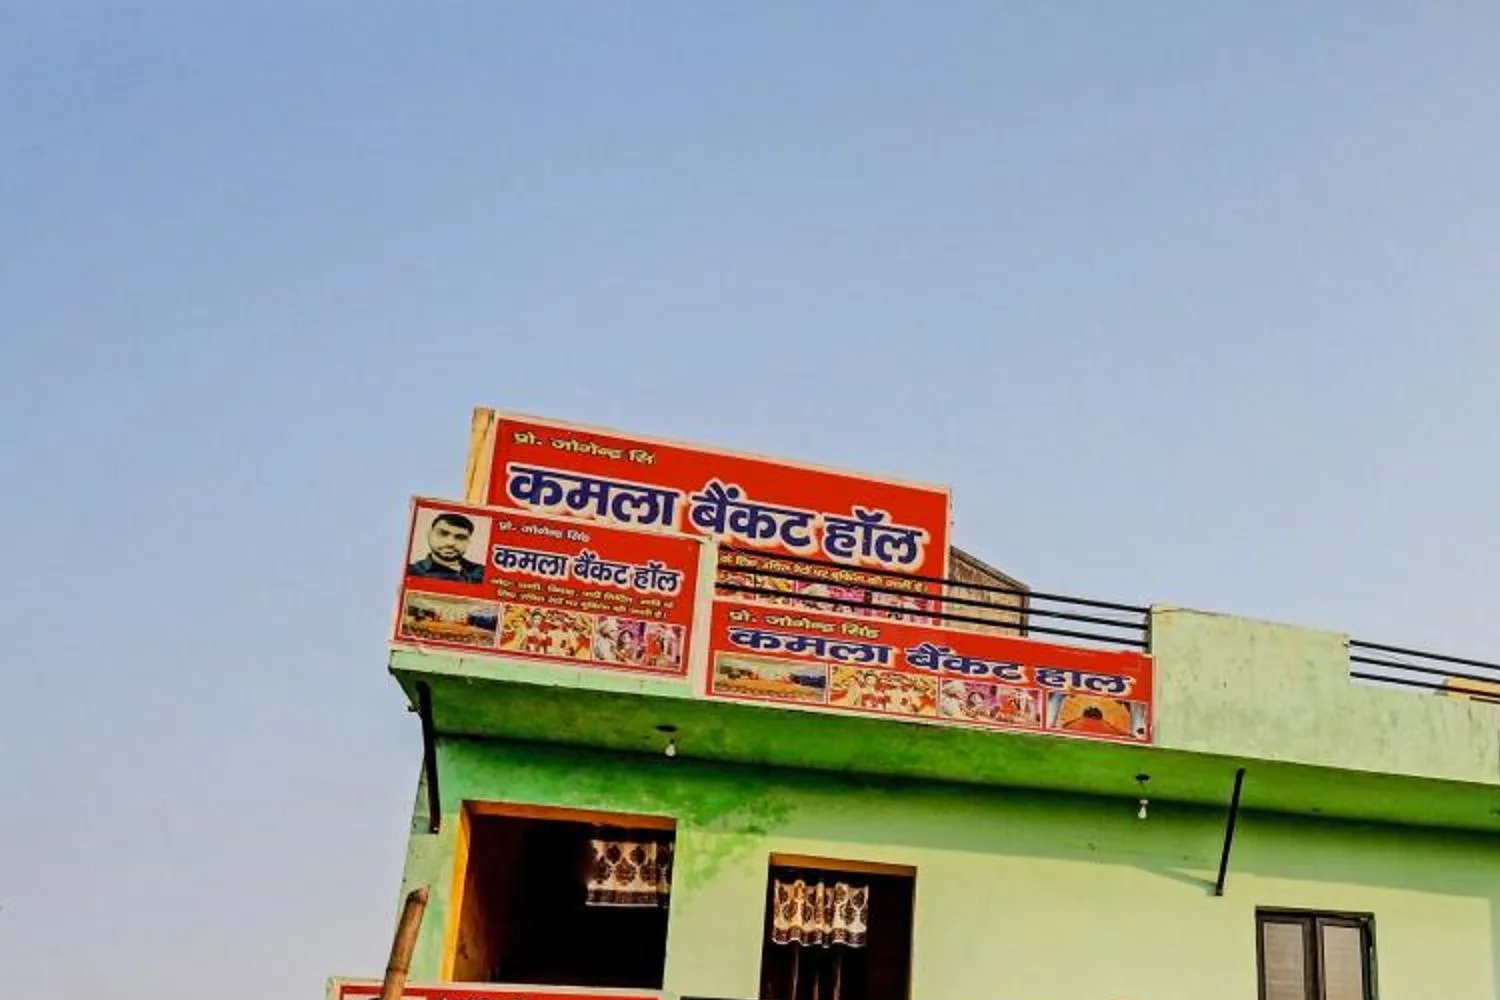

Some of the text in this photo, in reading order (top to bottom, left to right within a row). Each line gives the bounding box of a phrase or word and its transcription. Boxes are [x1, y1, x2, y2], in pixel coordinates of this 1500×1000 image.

[508, 463, 923, 566] कमला बैंकट हॉल
[493, 546, 569, 577] कमला
[573, 550, 630, 585] बैंकट
[633, 562, 681, 593] हॉल
[728, 626, 893, 665] कमला
[906, 642, 1026, 683] बैंकट
